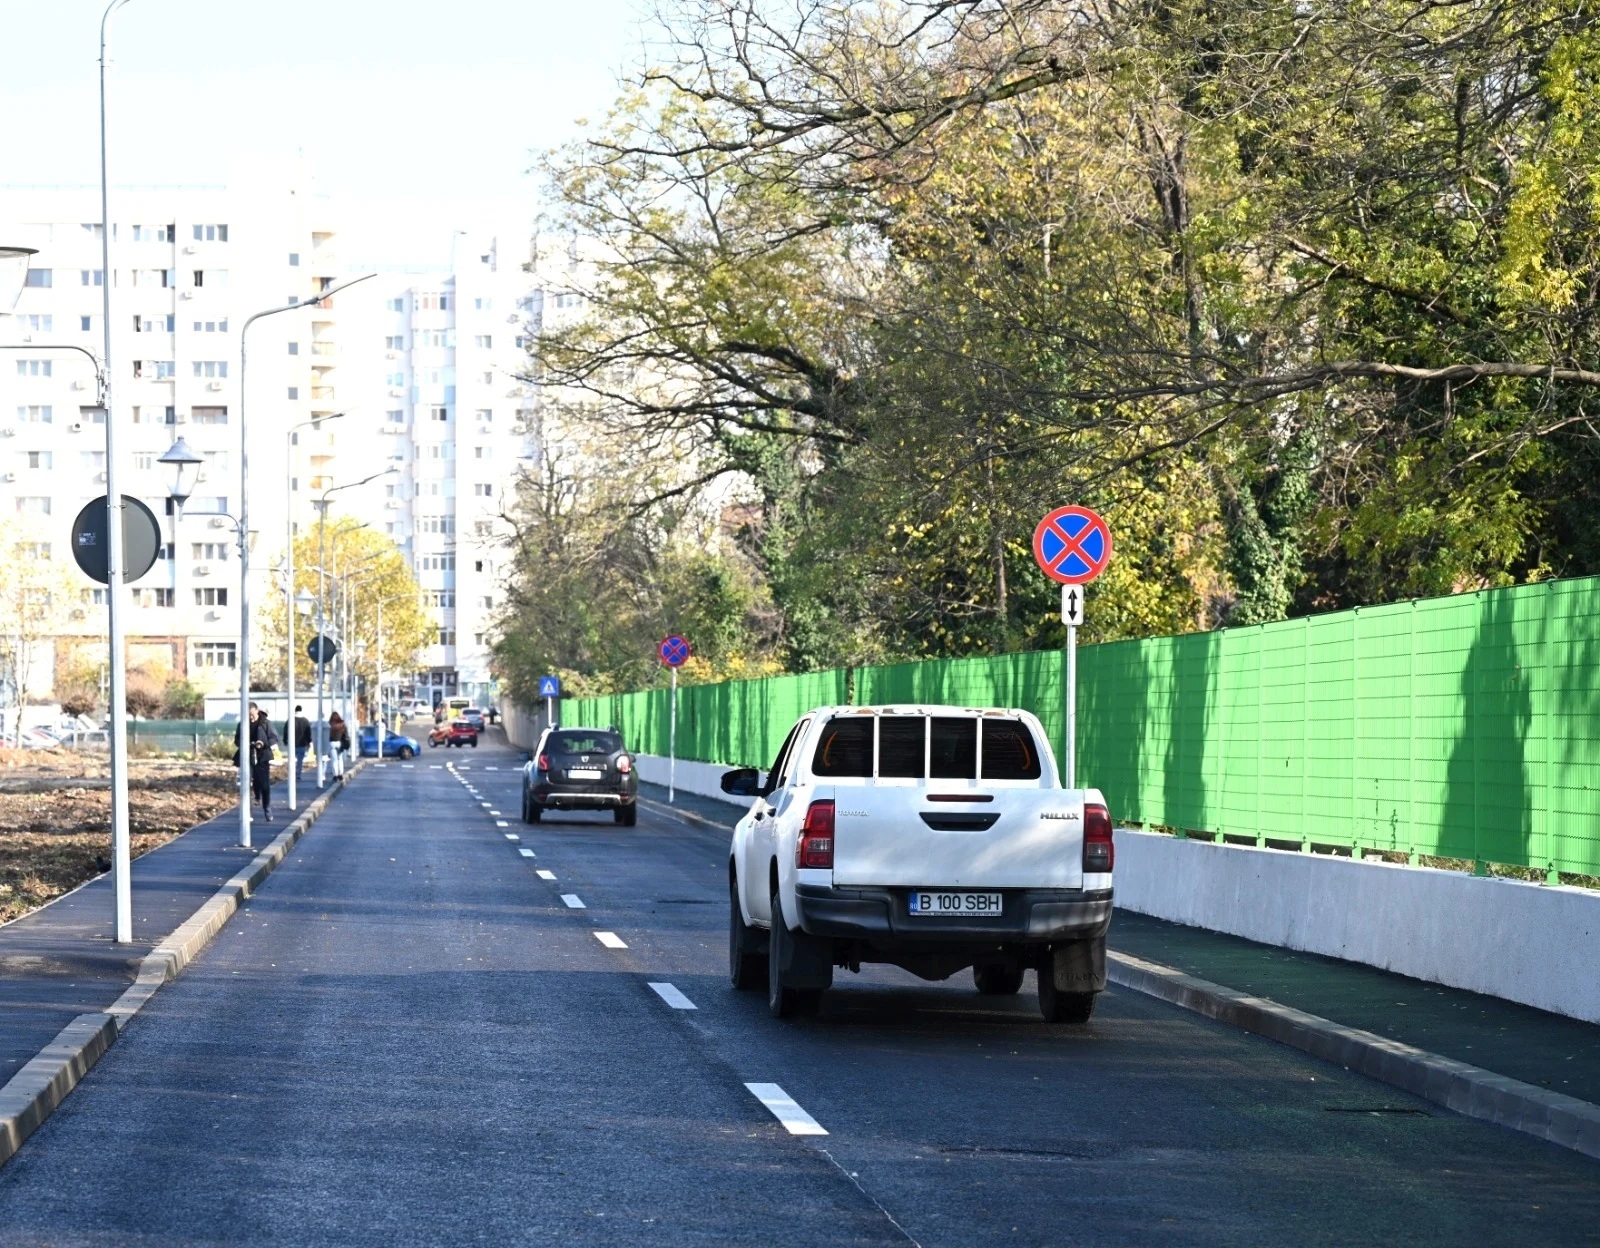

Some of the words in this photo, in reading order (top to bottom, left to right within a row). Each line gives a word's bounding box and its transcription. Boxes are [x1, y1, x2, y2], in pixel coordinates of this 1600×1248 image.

[1040, 812, 1079, 820] HILUX
[920, 895, 932, 910] B
[937, 895, 961, 910] 100
[965, 895, 999, 910] SBH
